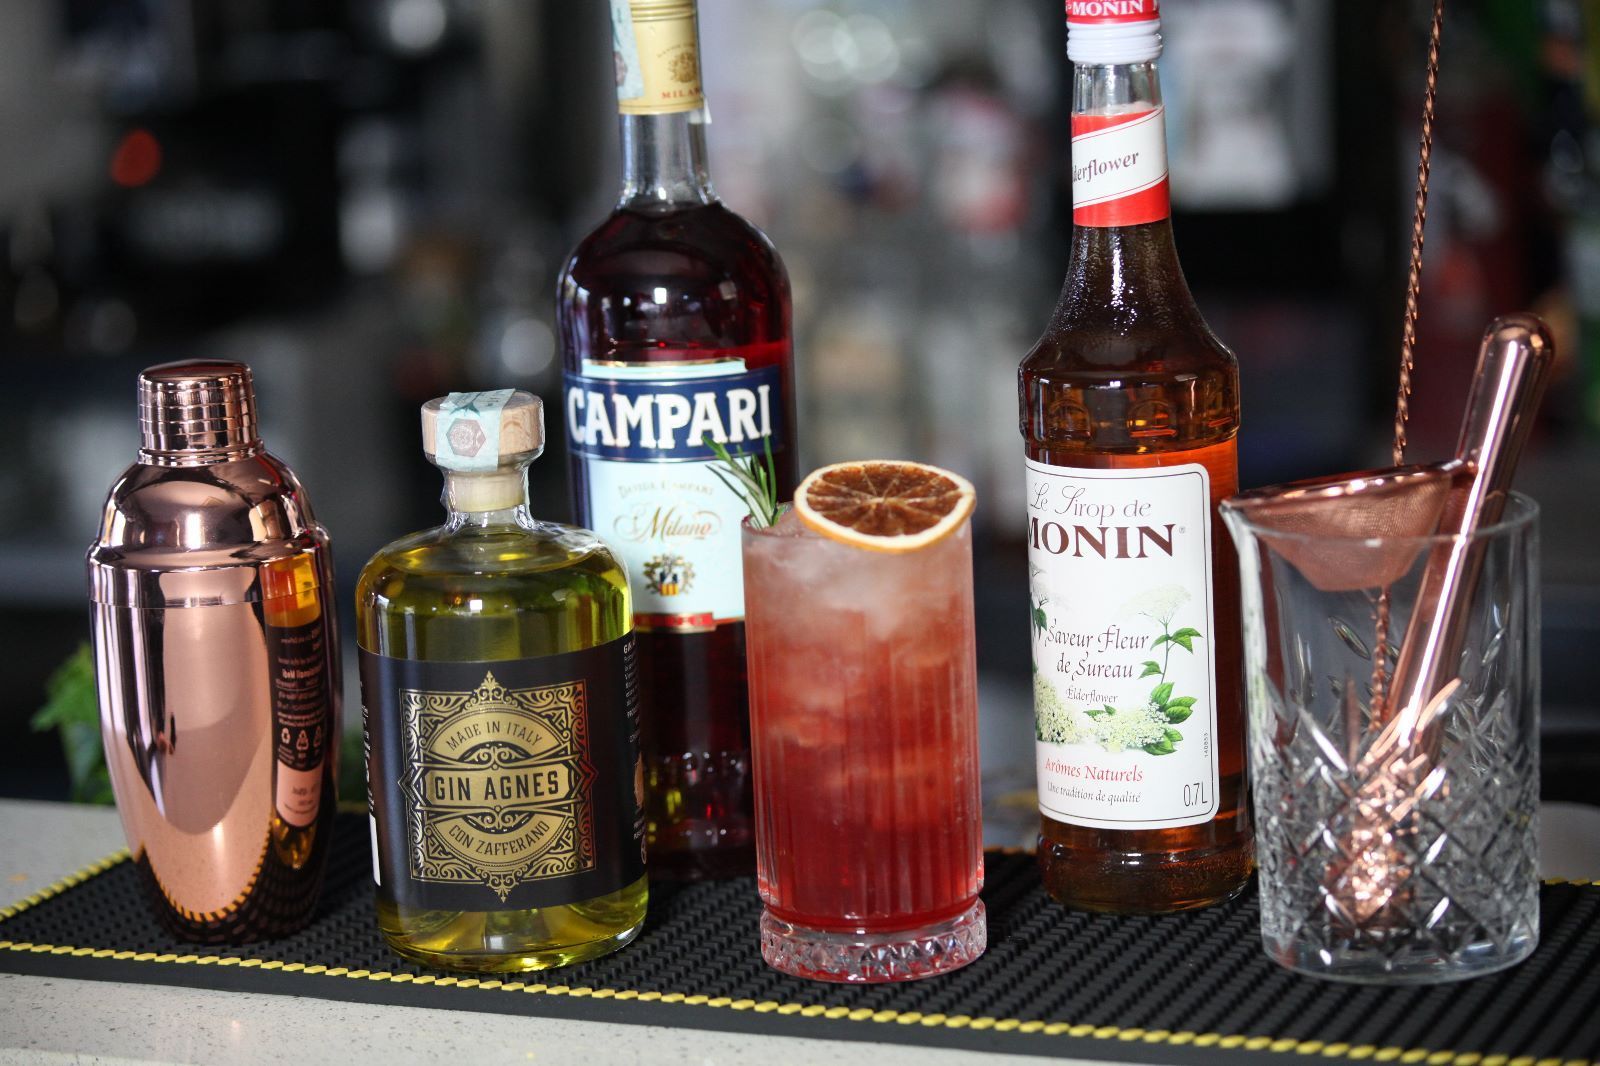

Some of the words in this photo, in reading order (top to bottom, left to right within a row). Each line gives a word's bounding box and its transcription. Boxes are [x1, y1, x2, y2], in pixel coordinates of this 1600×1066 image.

[1072, 0, 1143, 16] MONIN
[568, 385, 772, 449] CAMPARI
[1030, 482, 1049, 511] Le
[1054, 485, 1115, 525] Sirop
[1123, 499, 1151, 517] de
[613, 505, 722, 542] Milano
[1027, 512, 1177, 559] MONIN
[1044, 618, 1093, 648] Saveur
[1097, 624, 1149, 652] Fleur
[1056, 652, 1071, 674] de
[1071, 651, 1133, 681] Sureau
[1066, 686, 1118, 706] Elderflower
[446, 723, 482, 751] MADE
[487, 721, 501, 734] IN
[506, 720, 542, 748] ITALY
[434, 776, 471, 801] GIN
[484, 770, 559, 801] AGNES
[1045, 758, 1081, 778] Arômes
[1084, 764, 1143, 782] Naturels
[1060, 786, 1094, 801] tradition
[1095, 789, 1106, 802] de
[1107, 791, 1141, 806] qualité
[1183, 781, 1208, 806] 0.7L
[448, 824, 474, 849] CON
[475, 820, 550, 856] ZAFFERANO
